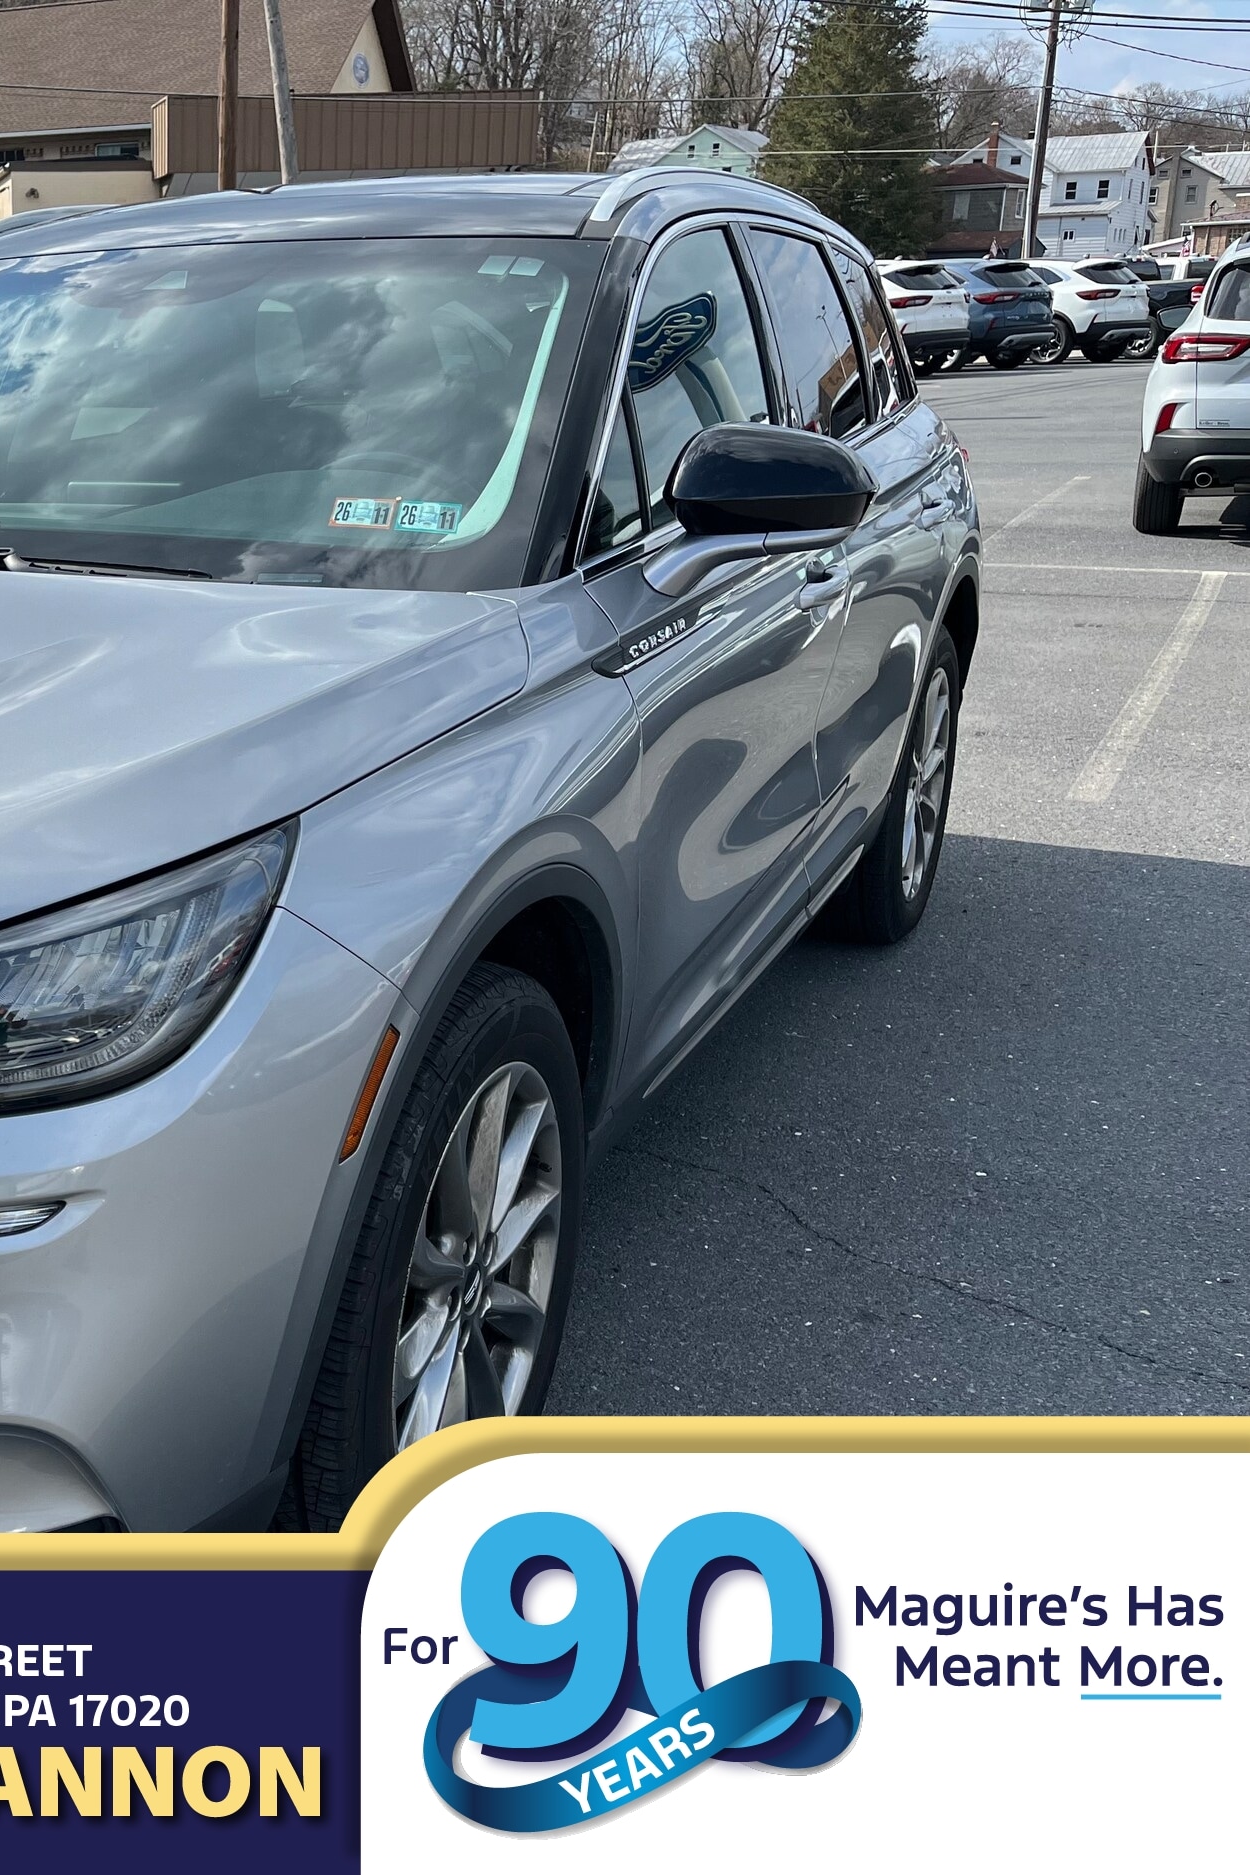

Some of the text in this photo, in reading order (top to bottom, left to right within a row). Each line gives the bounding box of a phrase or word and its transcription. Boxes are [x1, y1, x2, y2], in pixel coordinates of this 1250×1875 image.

[334, 502, 390, 525] 26 11
[400, 505, 456, 530] 26 11
[629, 617, 687, 658] CORSAIR
